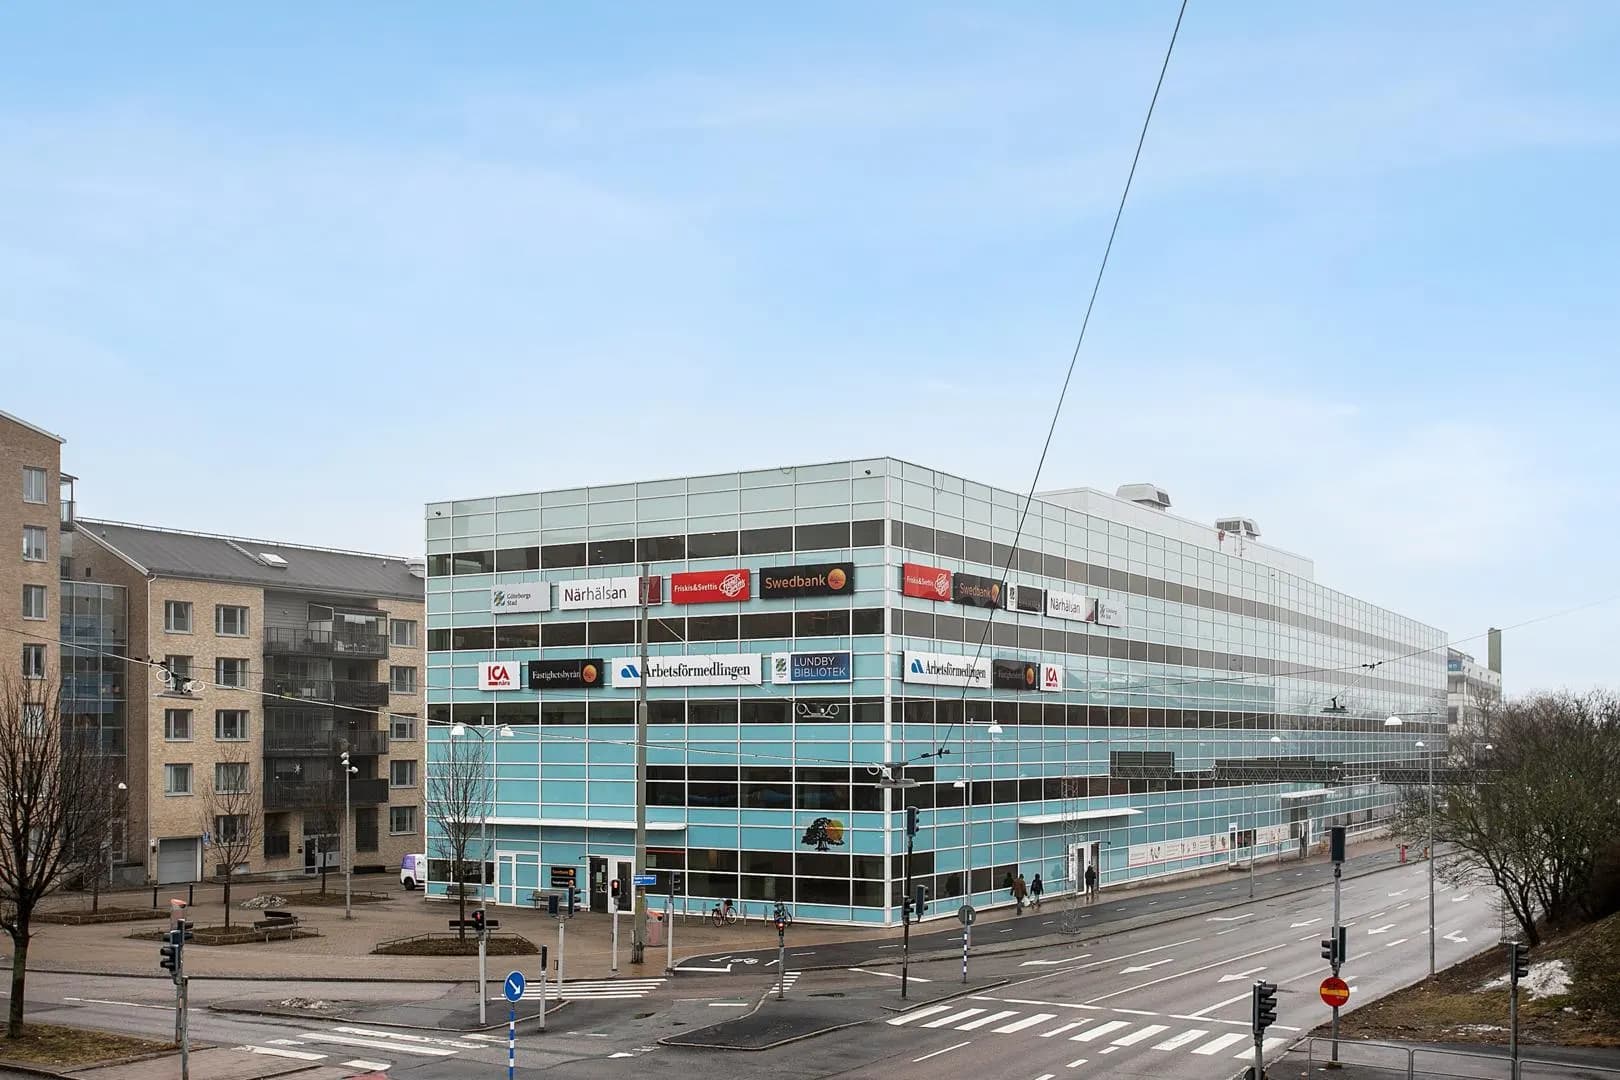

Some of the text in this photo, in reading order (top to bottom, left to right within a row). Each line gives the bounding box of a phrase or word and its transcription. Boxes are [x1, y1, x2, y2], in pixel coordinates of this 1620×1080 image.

[674, 583, 718, 593] Friskis&Svettis
[765, 574, 826, 590] Swedbank
[564, 586, 627, 602] Närhälsan
[959, 583, 992, 598] Swedbank
[794, 656, 835, 667] LUNDBY
[488, 665, 510, 680] ICA
[532, 670, 581, 681] Fastighetsbyrån
[794, 667, 847, 678] BIBLIOTEK
[1046, 667, 1058, 682] ICA
